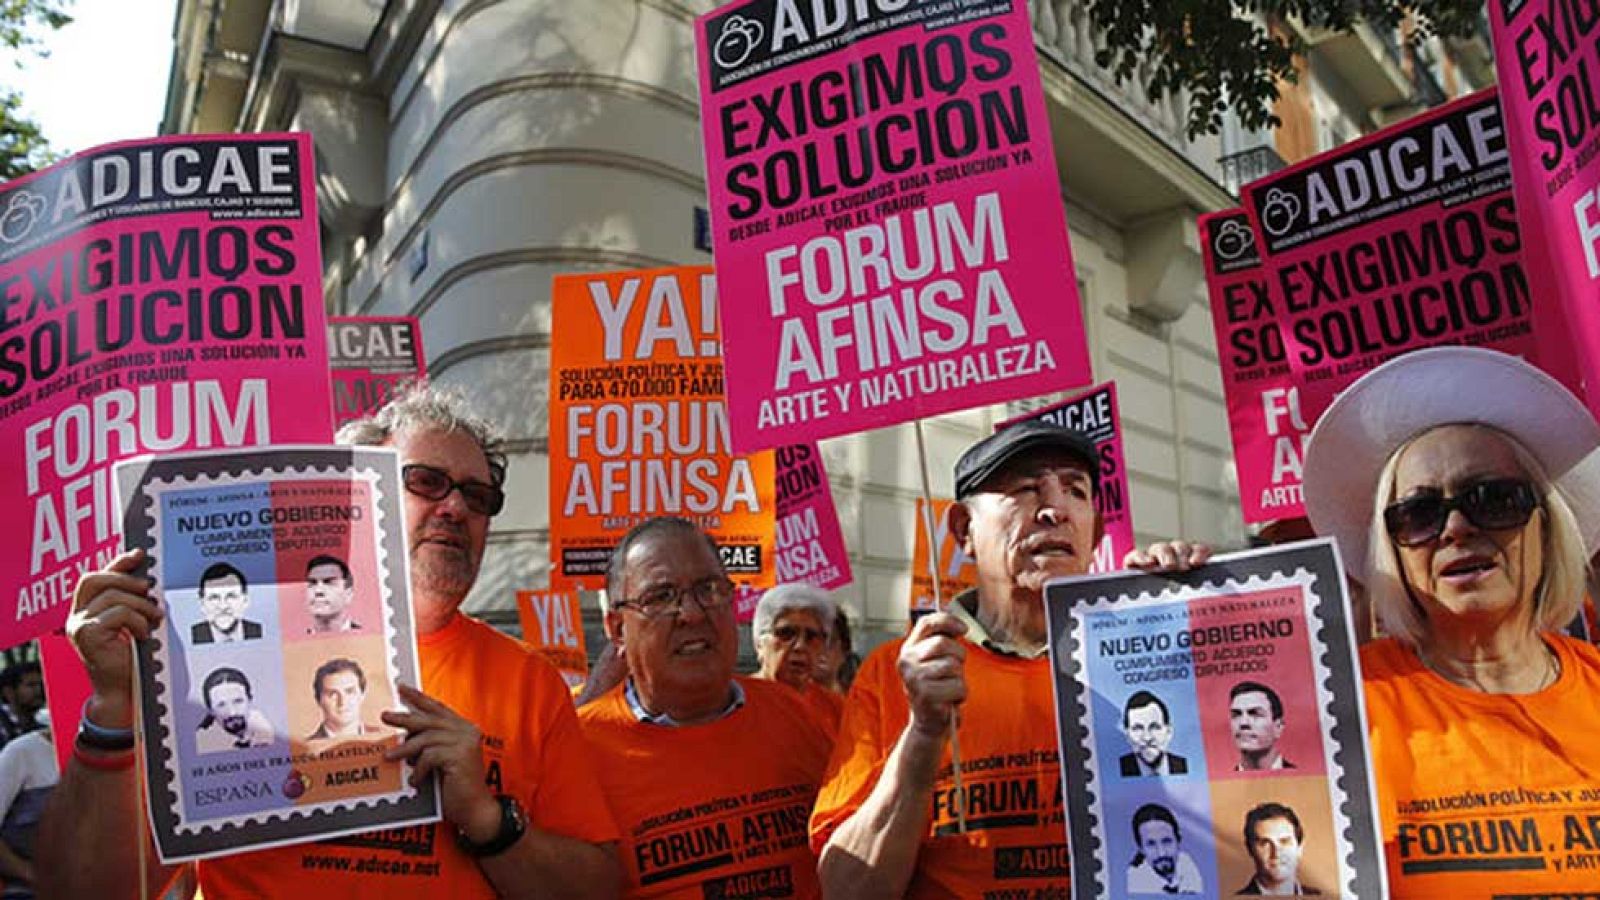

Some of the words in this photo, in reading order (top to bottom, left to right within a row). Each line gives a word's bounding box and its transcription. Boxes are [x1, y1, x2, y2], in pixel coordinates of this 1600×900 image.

[719, 24, 1013, 159] EXIGIMOS
[53, 146, 293, 223] ADICAE
[776, 204, 827, 231] ADICAE
[900, 171, 930, 191] UNA
[1011, 148, 1033, 166] YA
[1307, 105, 1511, 225] ADICAE
[0, 226, 296, 332] EXIGIMOS
[765, 193, 1009, 317] FORUM
[1278, 197, 1522, 315] EXIGIMOS
[284, 345, 306, 360] YA
[775, 269, 1027, 391] AFINSA
[559, 382, 605, 401] PARA
[757, 387, 830, 430] ARTE
[835, 383, 853, 413] Y
[860, 339, 1057, 409] NATURALEZA
[26, 378, 271, 495] FORUM
[177, 510, 254, 534] NUEVO
[258, 505, 363, 526] GOBIERNO
[563, 458, 761, 517] AFINSA
[16, 564, 75, 622] ARTE
[1099, 633, 1171, 658] NUEVO
[1177, 618, 1294, 649] GOBIERNO
[325, 767, 380, 787] ADICAE
